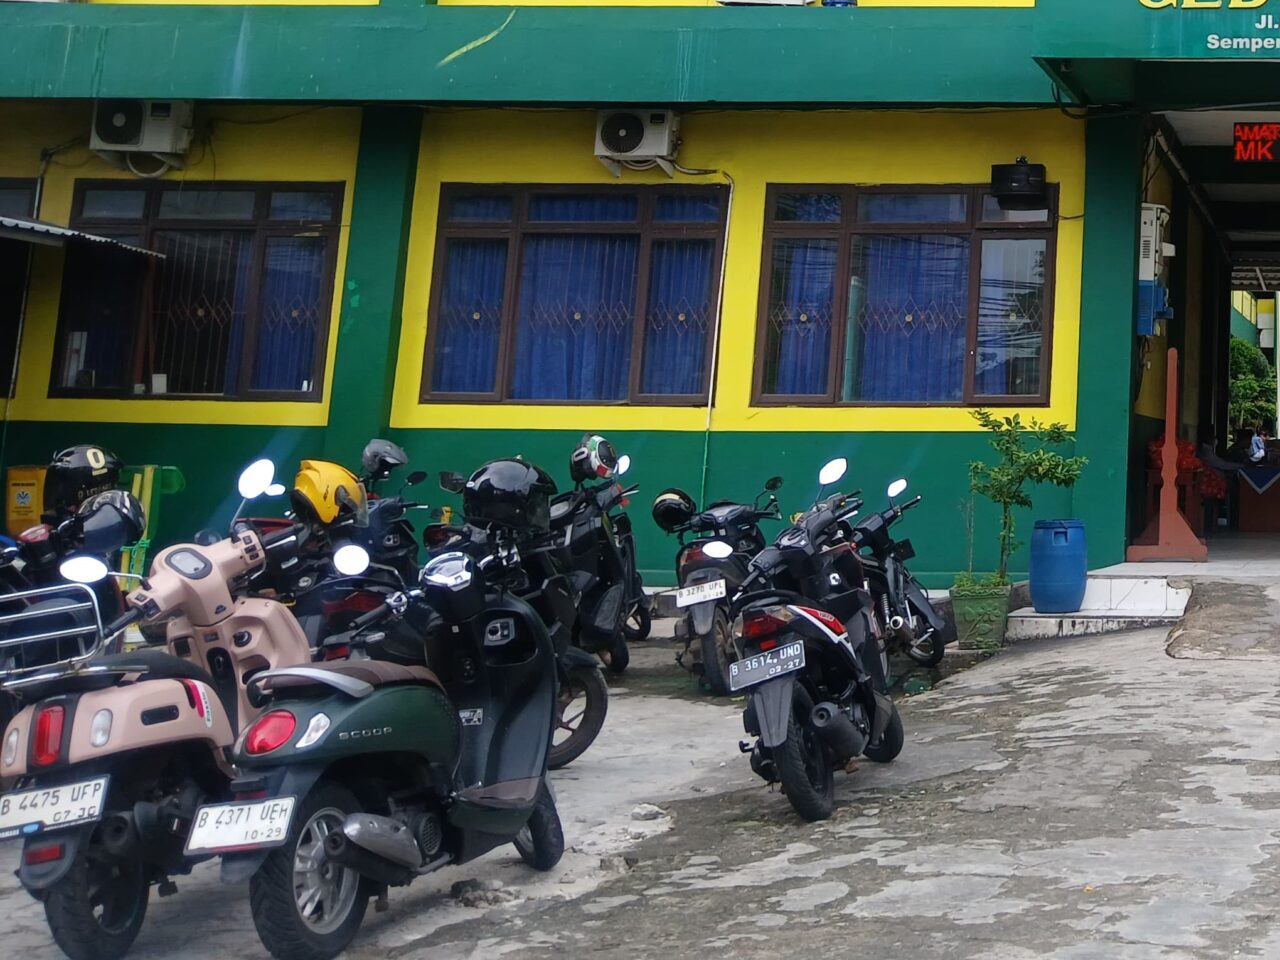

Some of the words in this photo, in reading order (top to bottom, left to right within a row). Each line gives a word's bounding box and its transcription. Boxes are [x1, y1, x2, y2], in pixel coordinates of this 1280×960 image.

[731, 665, 739, 677] B
[780, 644, 801, 660] UND
[1, 798, 11, 816] B
[18, 789, 61, 811] 4475
[71, 782, 102, 803] UFP
[198, 811, 209, 828] B
[215, 806, 251, 826] 4371
